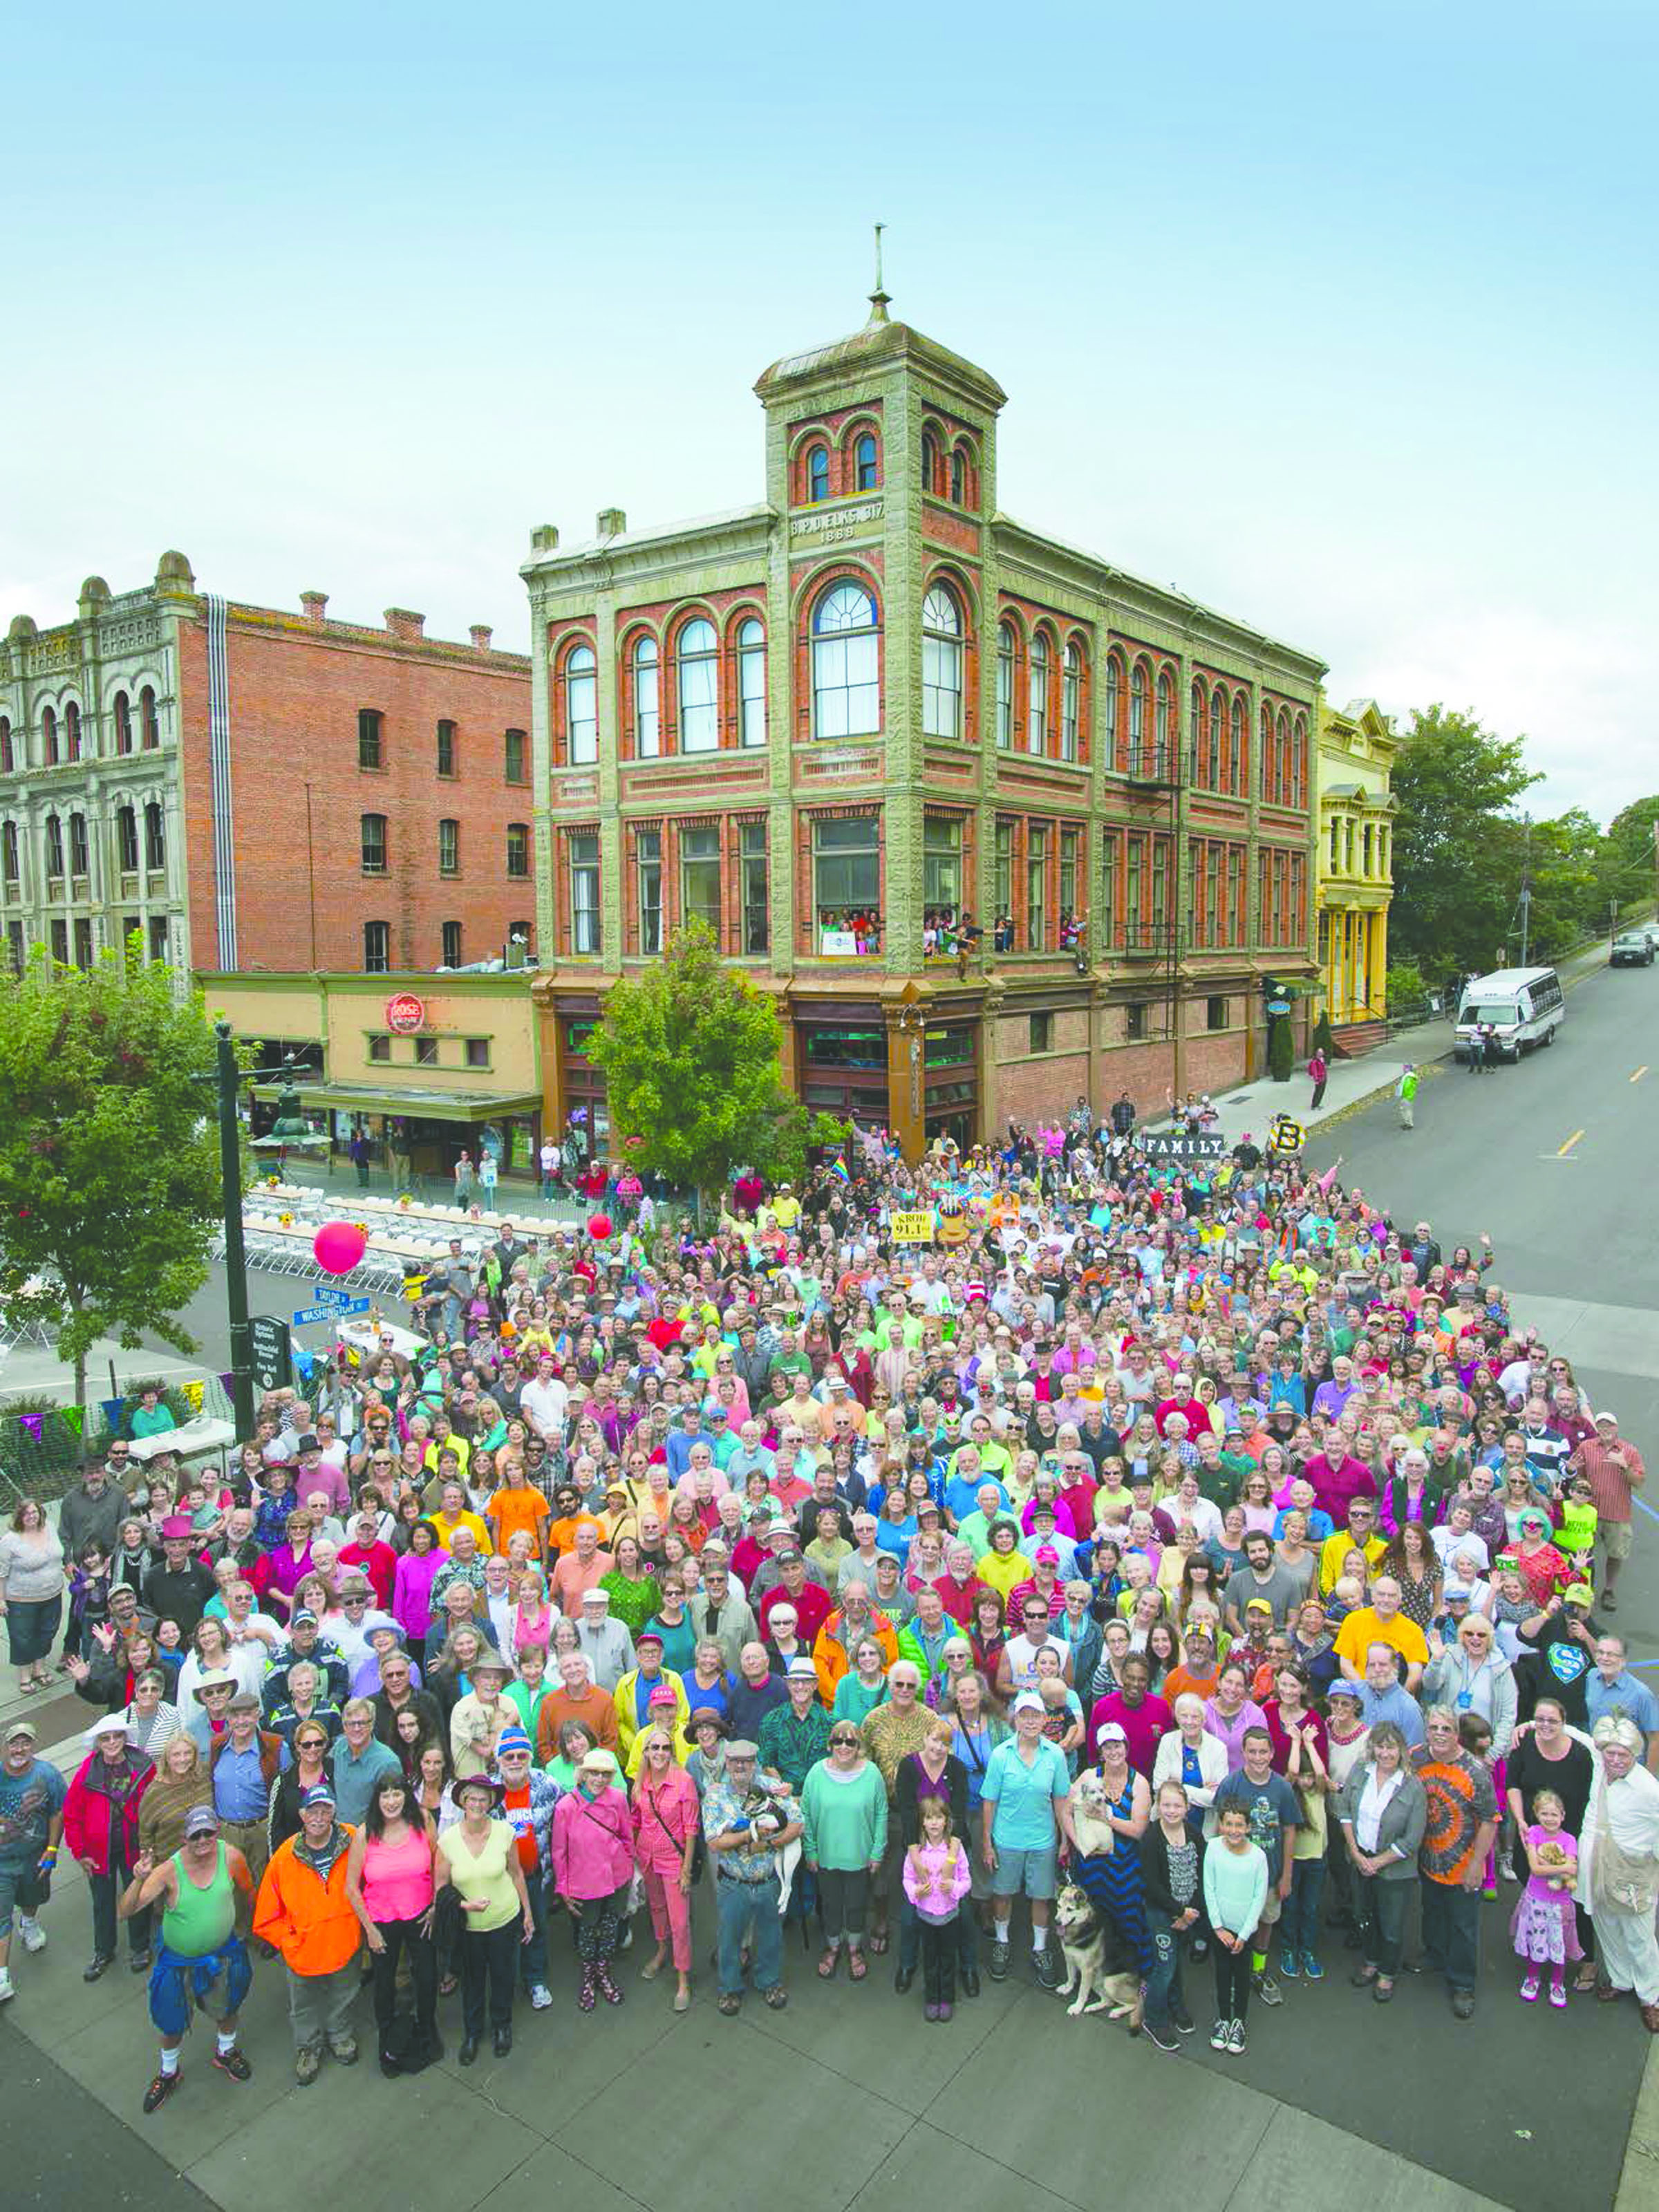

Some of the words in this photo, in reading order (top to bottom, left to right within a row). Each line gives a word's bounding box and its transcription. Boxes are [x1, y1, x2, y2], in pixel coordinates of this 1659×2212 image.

[821, 526, 854, 543] 1889
[393, 1004, 420, 1015] ROSE
[1277, 1123, 1300, 1150] B
[1146, 1139, 1222, 1154] FAMILY
[896, 1225, 921, 1234] 91.1
[302, 1302, 355, 1322] WASHINGTON
